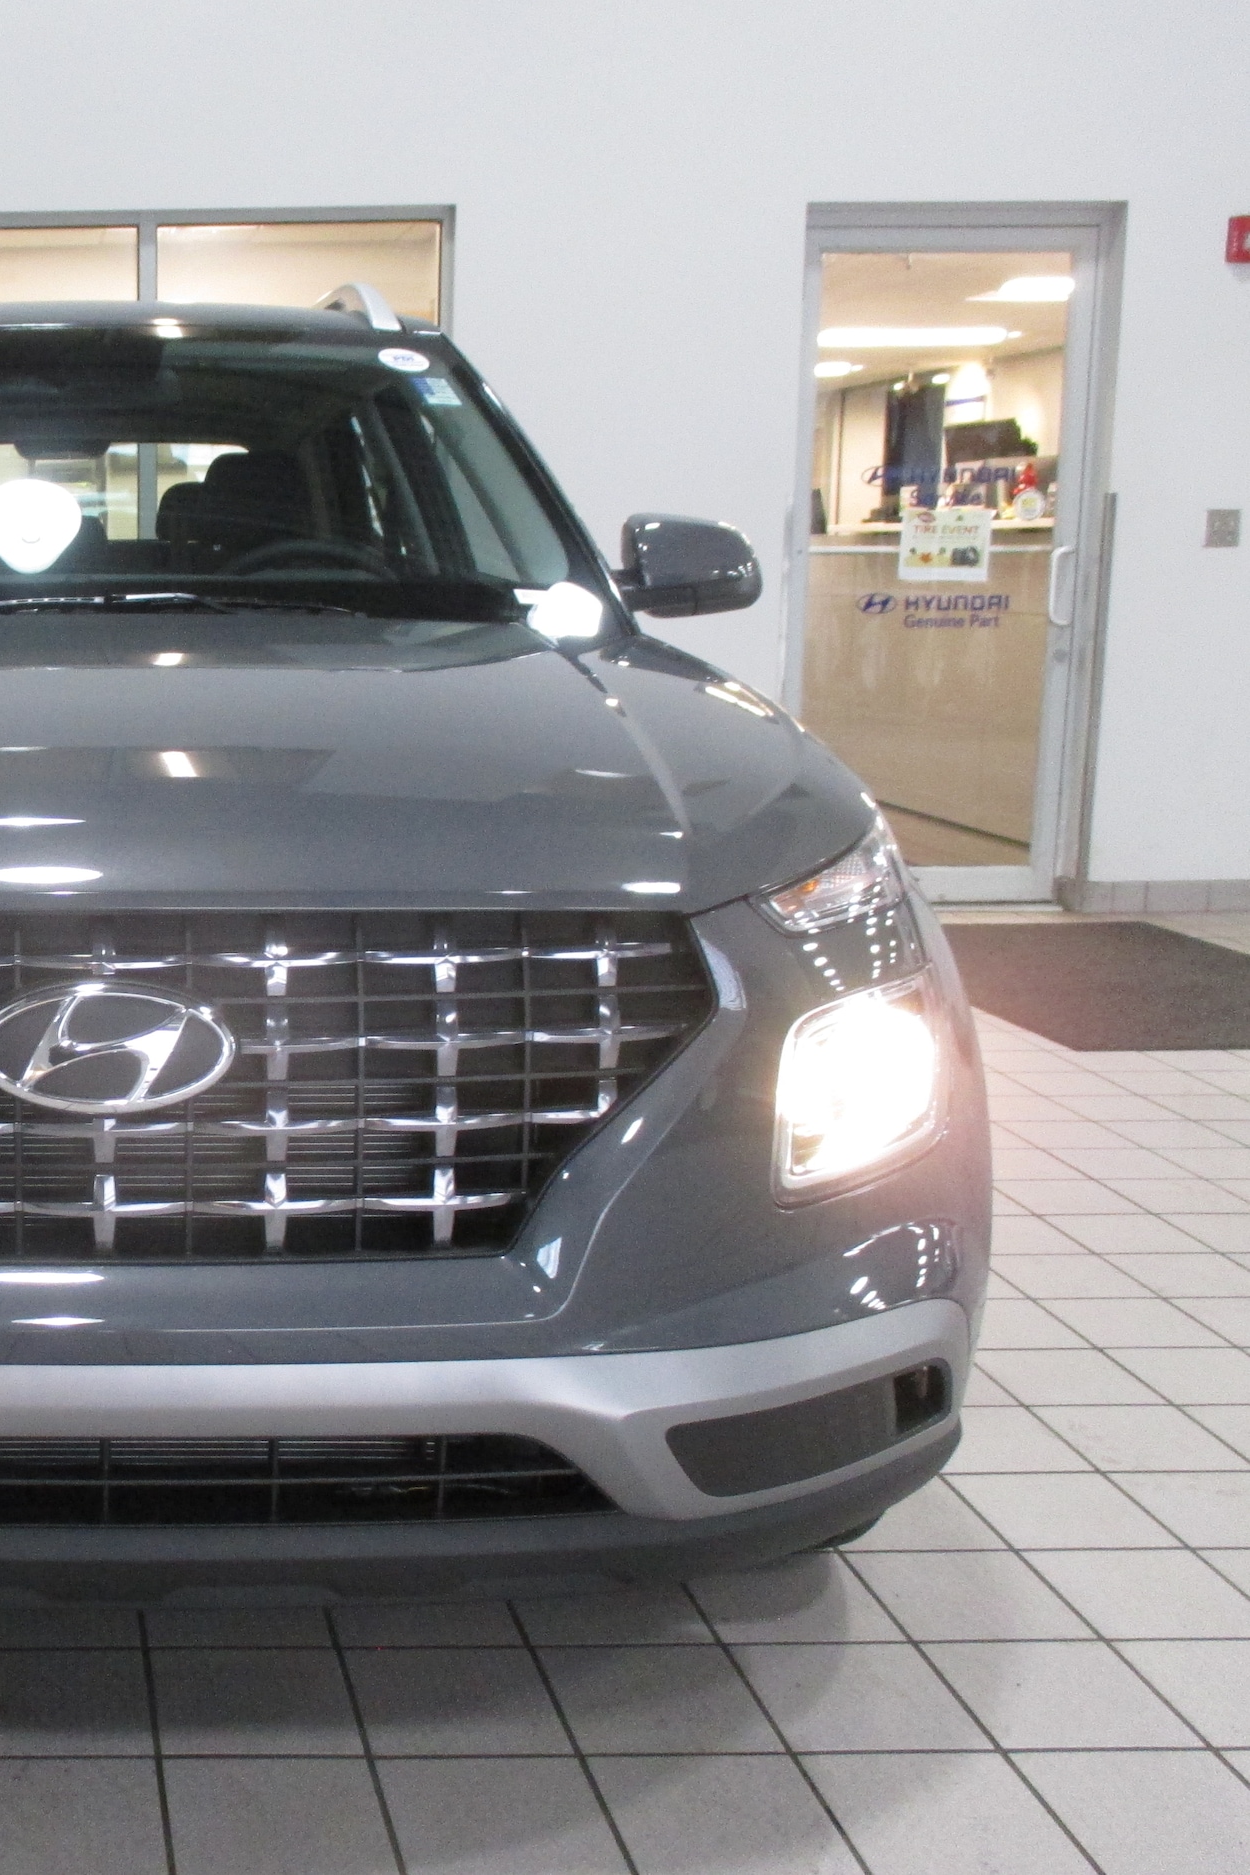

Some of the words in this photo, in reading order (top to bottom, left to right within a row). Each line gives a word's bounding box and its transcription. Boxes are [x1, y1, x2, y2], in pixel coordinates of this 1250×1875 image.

[941, 524, 979, 534] EVENT
[904, 595, 1010, 611] HYUNDAI
[904, 614, 965, 628] Genuine
[970, 614, 999, 628] Part
